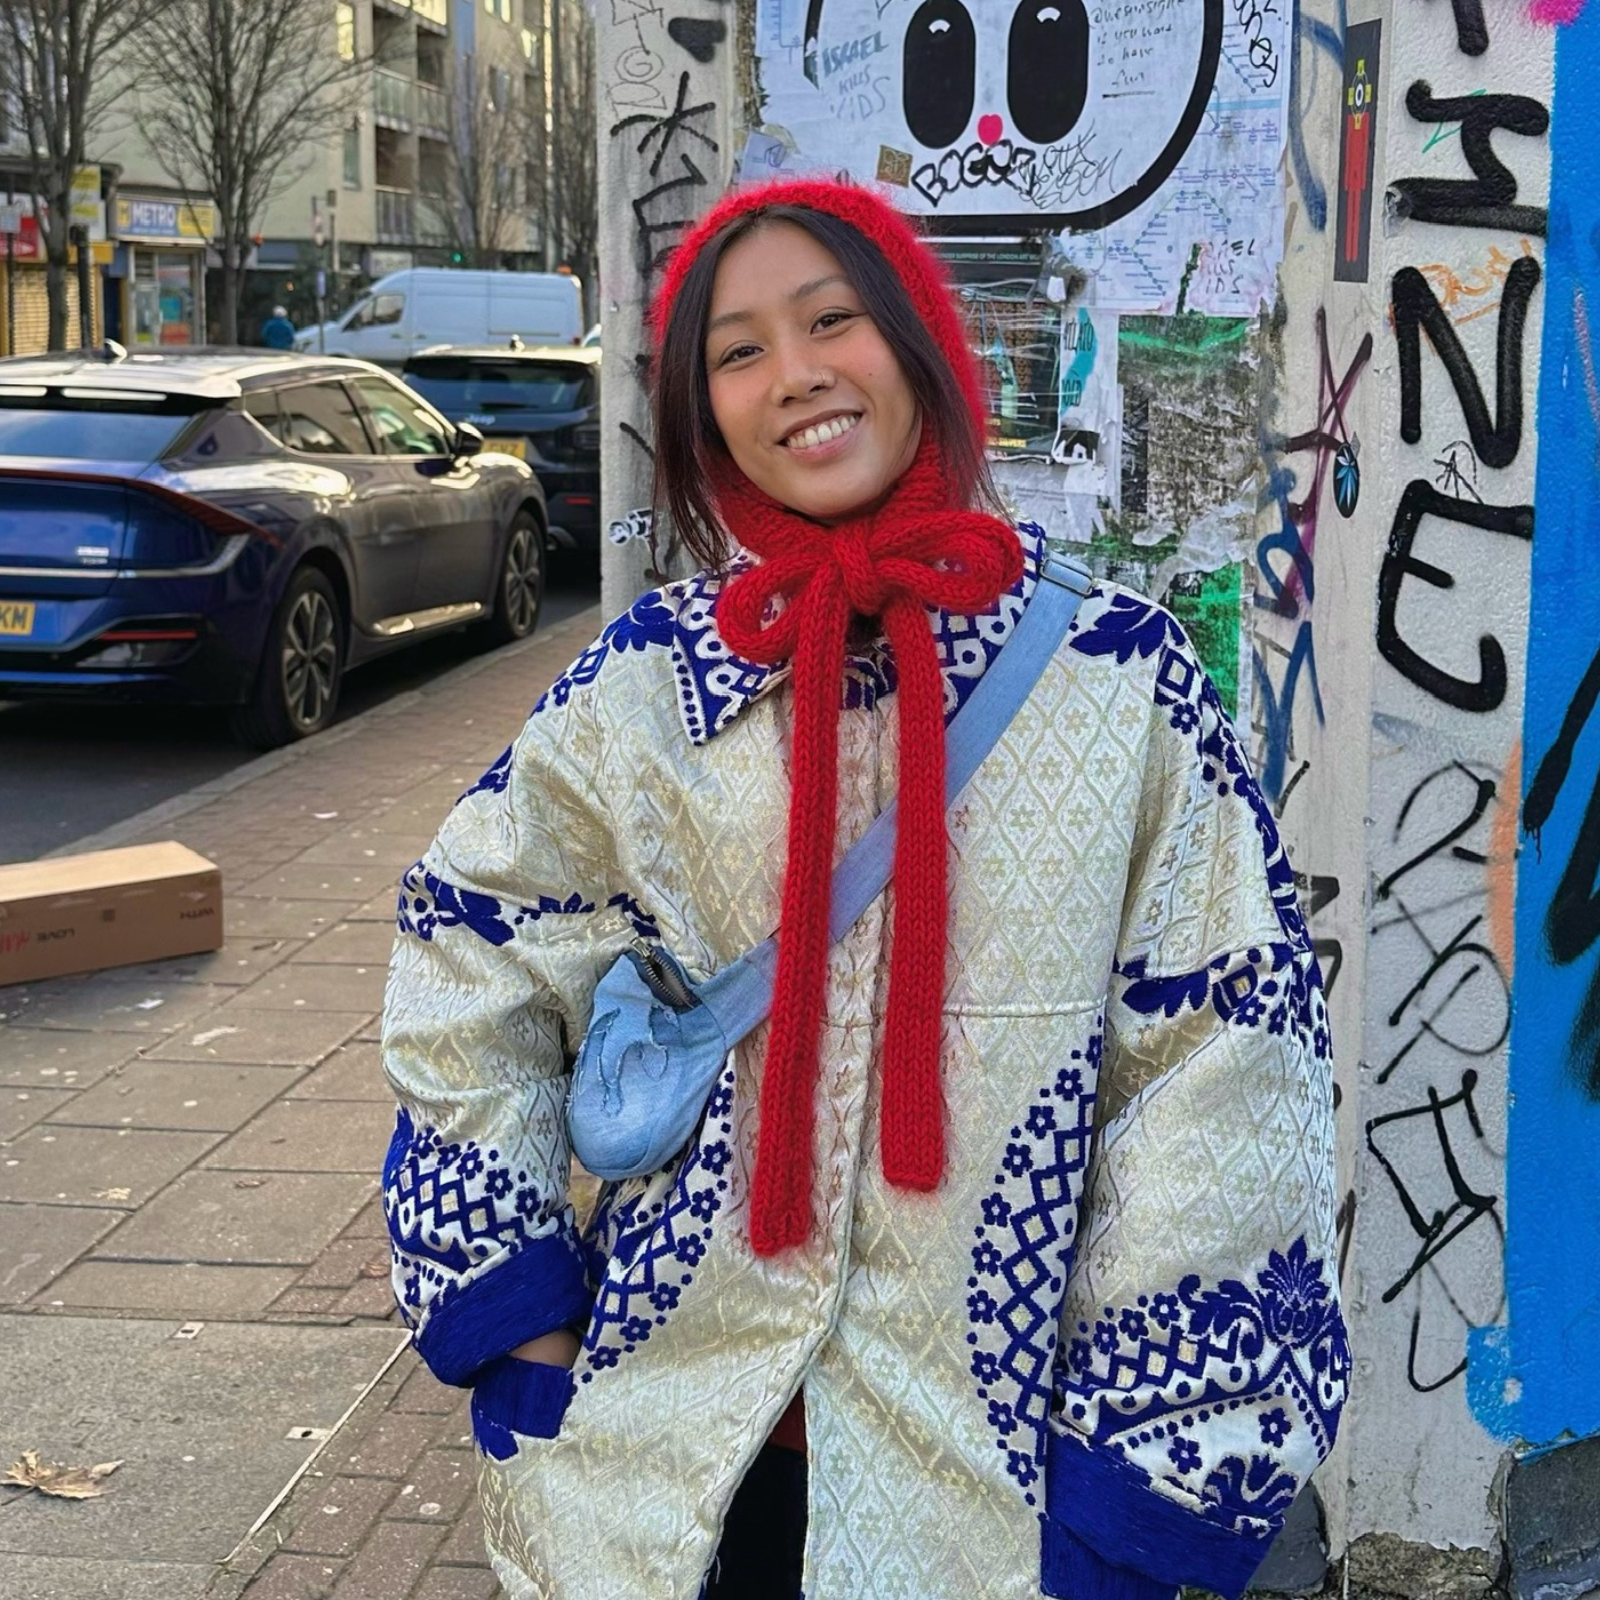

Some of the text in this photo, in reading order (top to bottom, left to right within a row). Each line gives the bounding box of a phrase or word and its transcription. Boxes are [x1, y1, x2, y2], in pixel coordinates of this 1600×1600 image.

[822, 30, 890, 79] ISRAEL
[838, 63, 871, 96] KILLS
[132, 201, 176, 227] METRO
[465, 413, 496, 425] Jeep
[36, 928, 75, 943] LOVE
